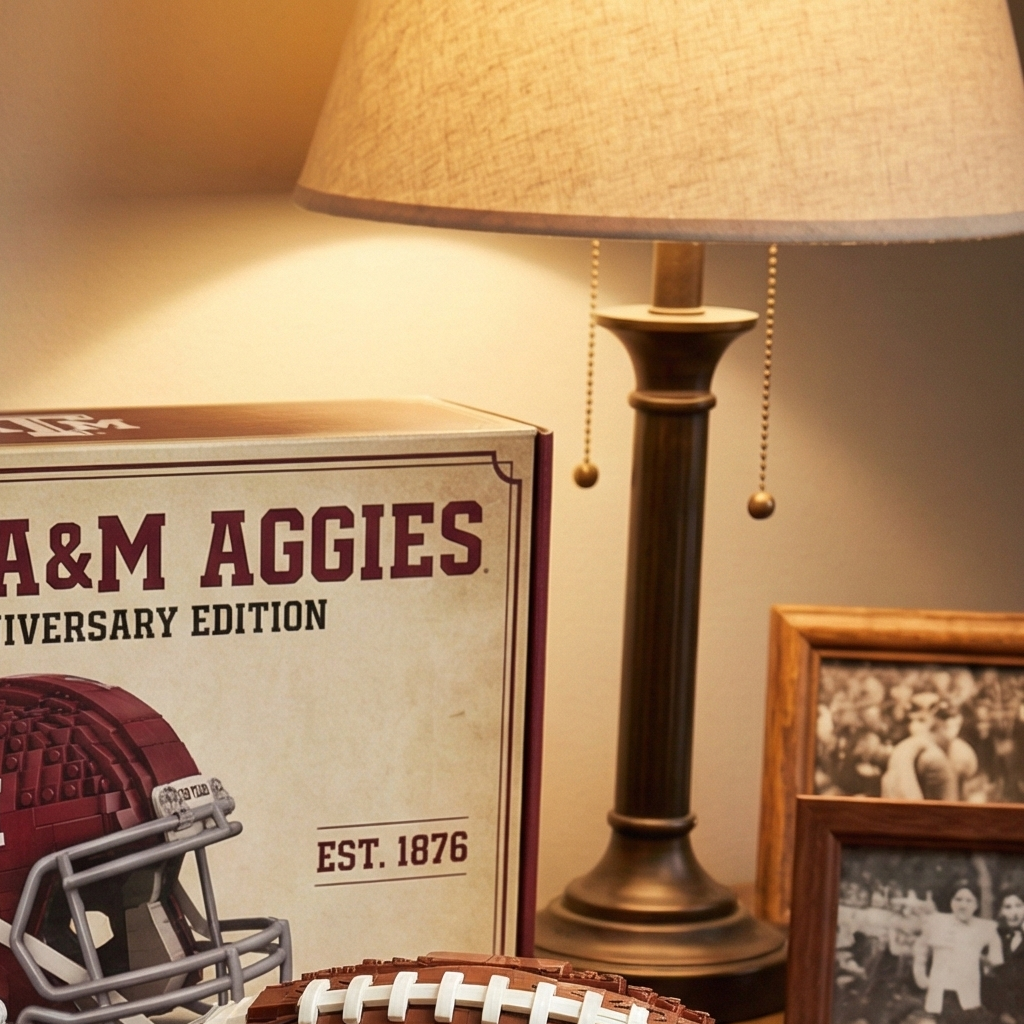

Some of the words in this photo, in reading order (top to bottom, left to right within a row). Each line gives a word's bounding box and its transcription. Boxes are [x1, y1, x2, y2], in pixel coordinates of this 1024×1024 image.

[200, 500, 483, 588] AGGIES
[191, 599, 328, 636] EDITION
[317, 838, 385, 873] EST.
[398, 831, 468, 867] 1876
